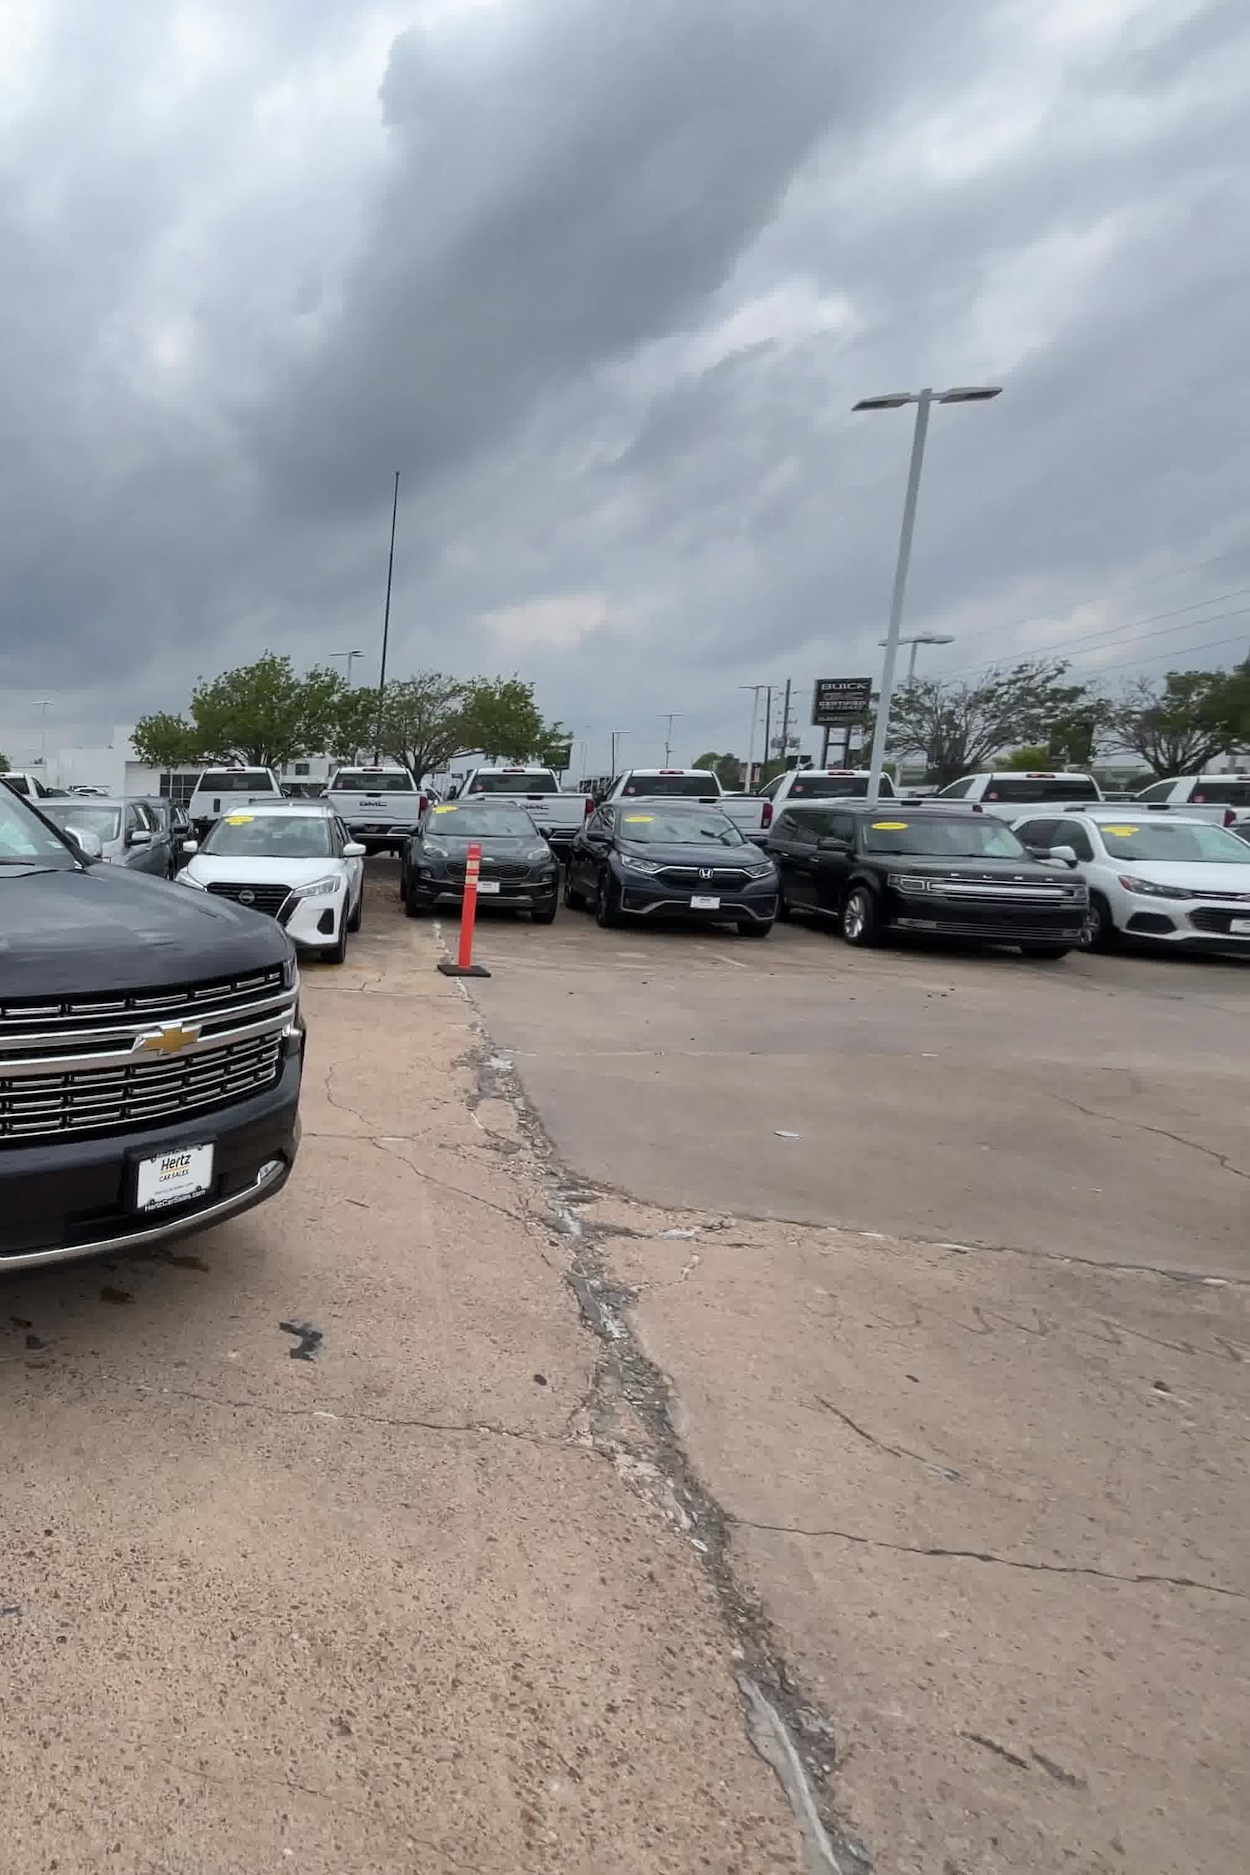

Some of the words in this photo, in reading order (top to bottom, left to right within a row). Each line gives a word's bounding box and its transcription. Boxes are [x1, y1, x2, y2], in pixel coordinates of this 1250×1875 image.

[821, 681, 869, 690] BUICK
[161, 1154, 191, 1171] Hertz
[159, 1173, 171, 1183] CAR
[172, 1168, 189, 1179] SALES
[144, 1189, 207, 1212] HertzCarSales.com
